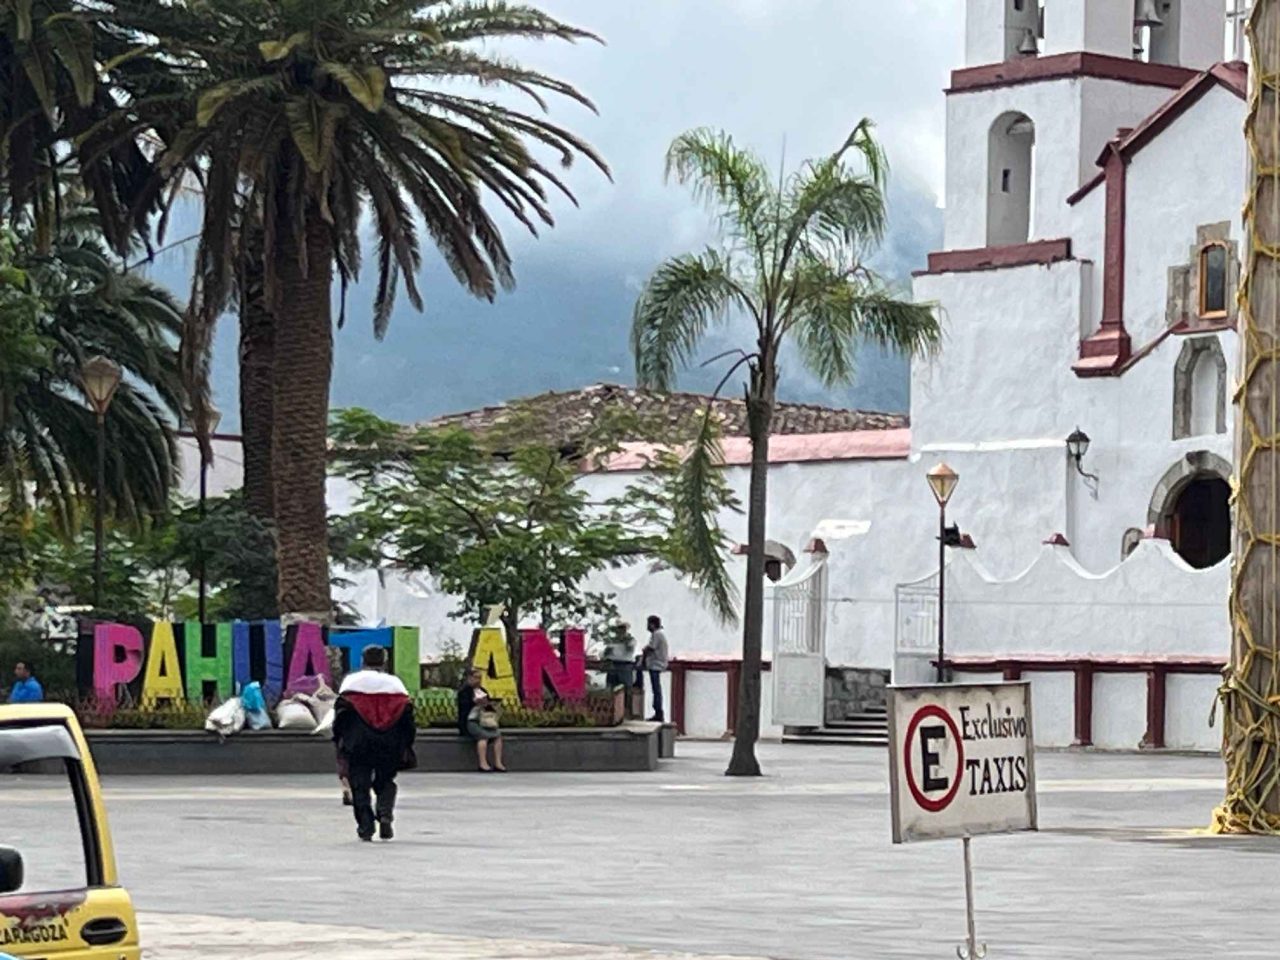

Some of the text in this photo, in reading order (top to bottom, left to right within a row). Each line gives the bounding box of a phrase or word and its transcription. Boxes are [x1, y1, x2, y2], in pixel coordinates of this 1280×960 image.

[959, 702, 1027, 741] Exclusivo
[919, 725, 949, 792] E
[966, 756, 1027, 796] TAXIS
